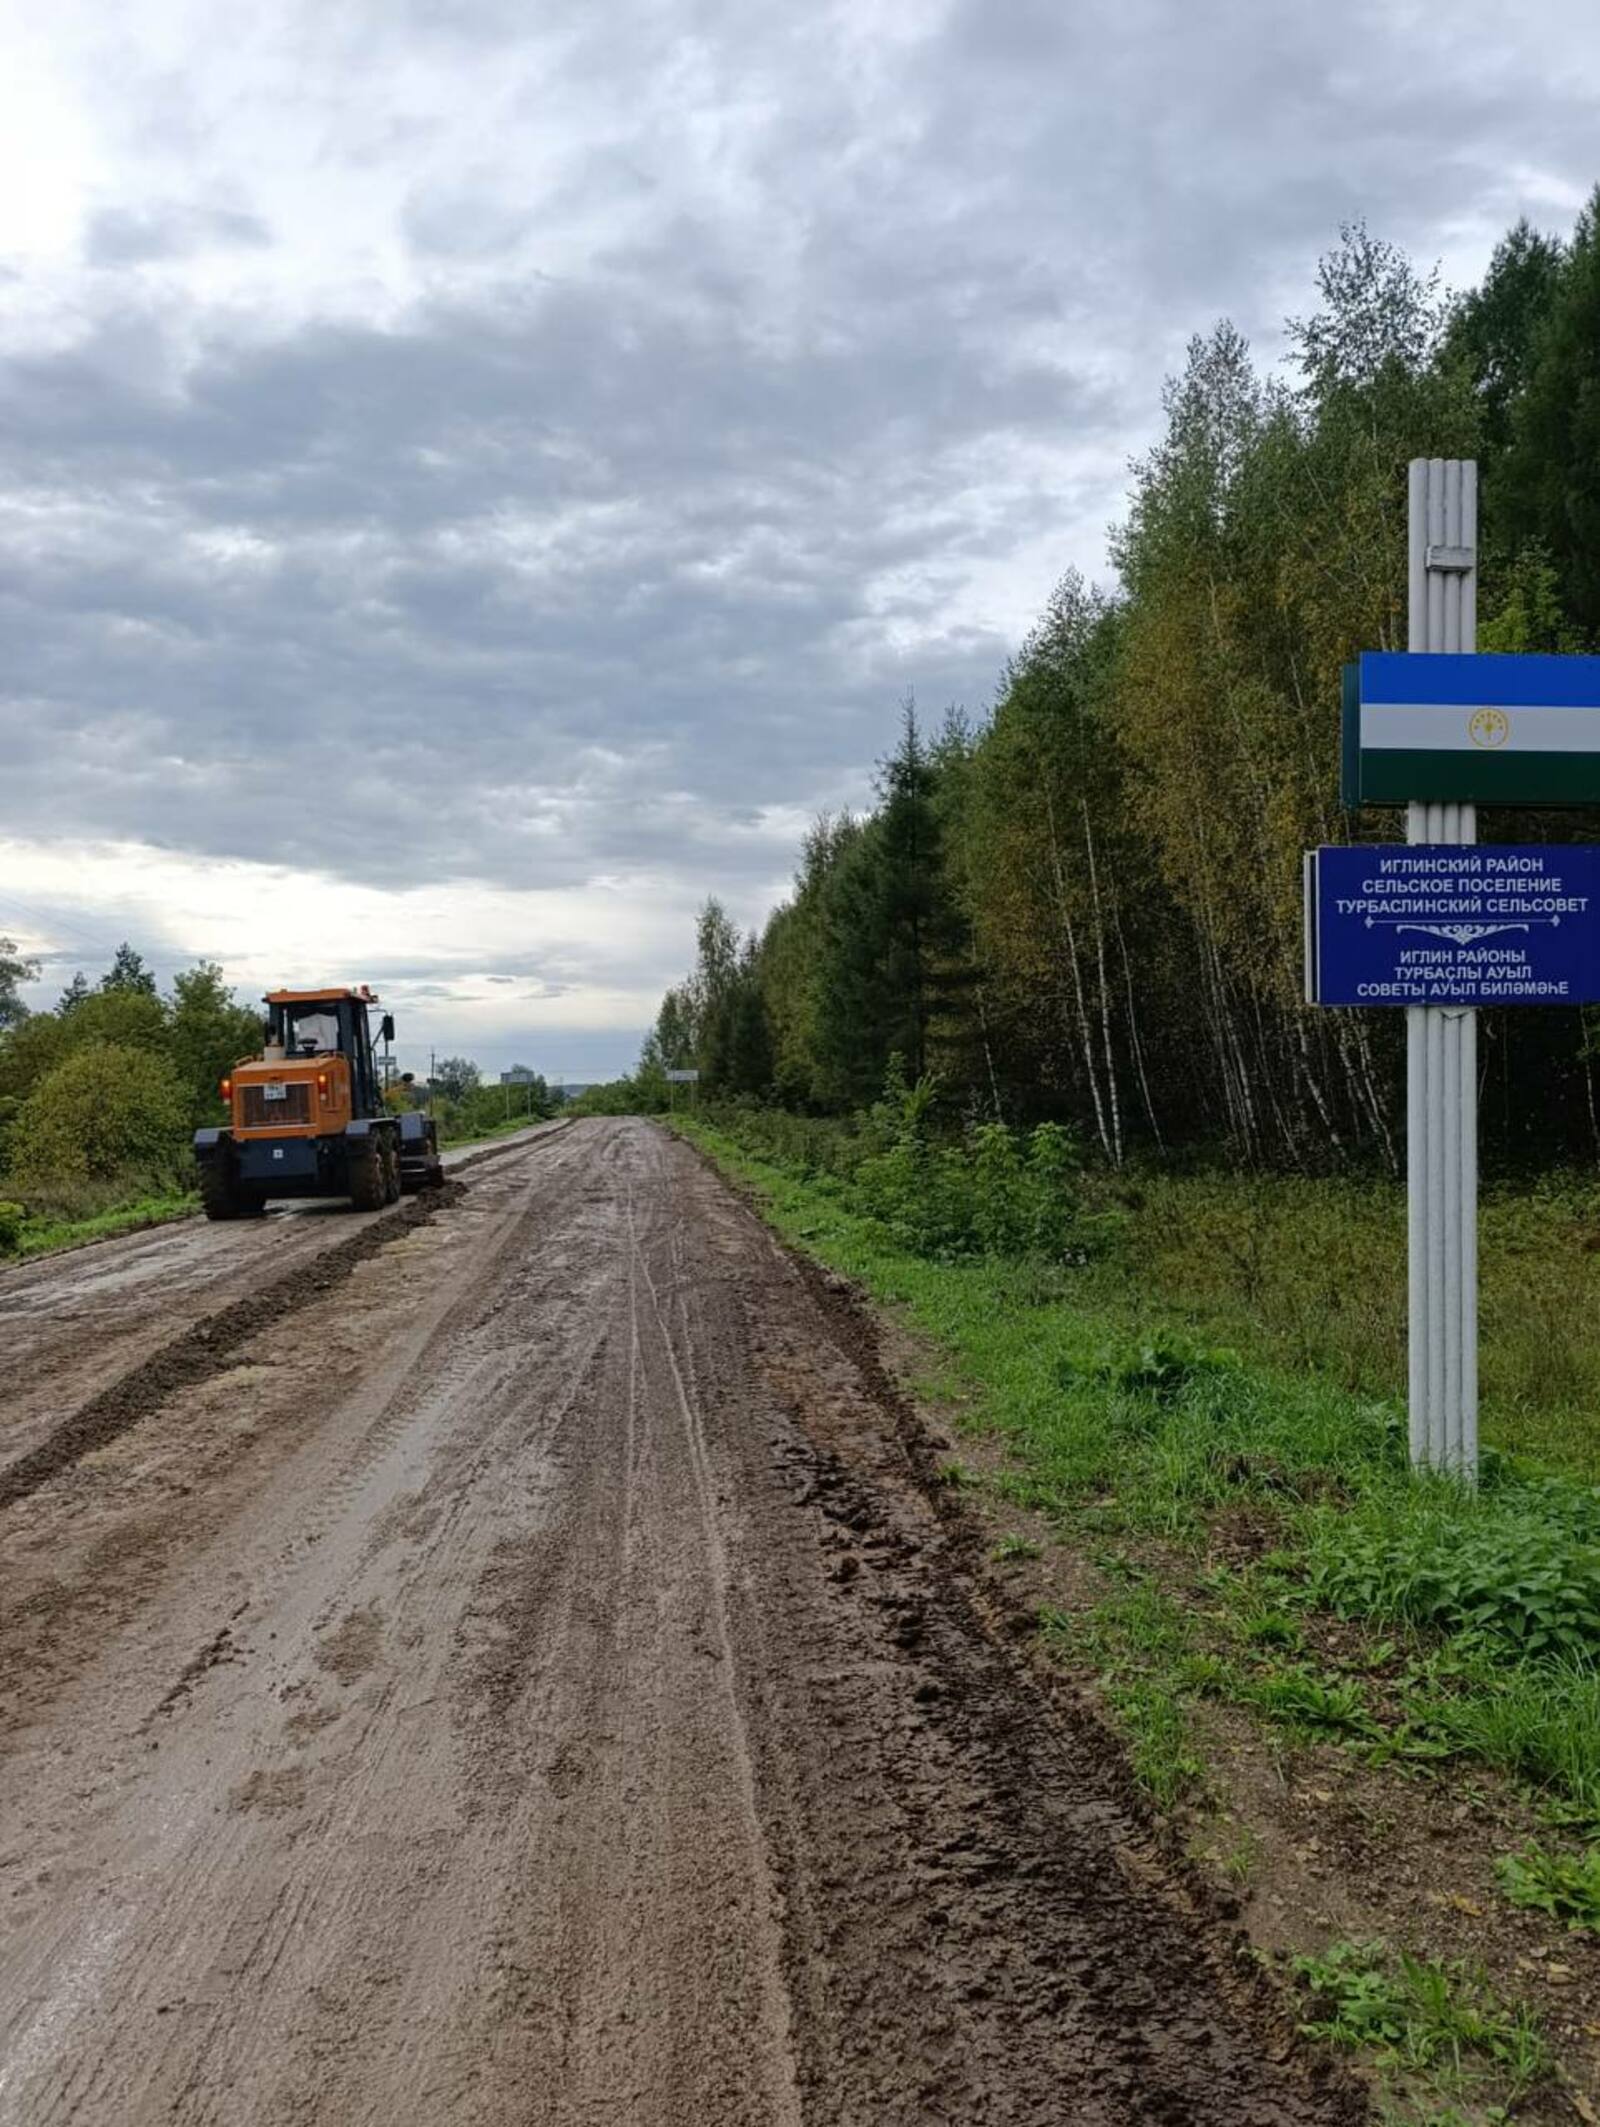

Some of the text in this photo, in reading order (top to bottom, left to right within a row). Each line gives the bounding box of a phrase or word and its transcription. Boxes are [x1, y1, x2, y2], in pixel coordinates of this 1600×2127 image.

[1380, 855, 1544, 874] ИГЛИНСКИЙ РАЙОН
[1362, 878, 1562, 894] СЕЛЬСКОЕ ПОСЕЛЕНИЕ
[1336, 897, 1588, 914] ТУРБАСЛИНСКИЙ СЕЛЬСОВЕТ
[1400, 948, 1526, 963] ИГЛИН РАЙОНЫ
[1486, 966, 1532, 979] АУЫЛ
[1357, 983, 1425, 996] СОВЕТЫ
[1430, 983, 1476, 996] АУЫЛ
